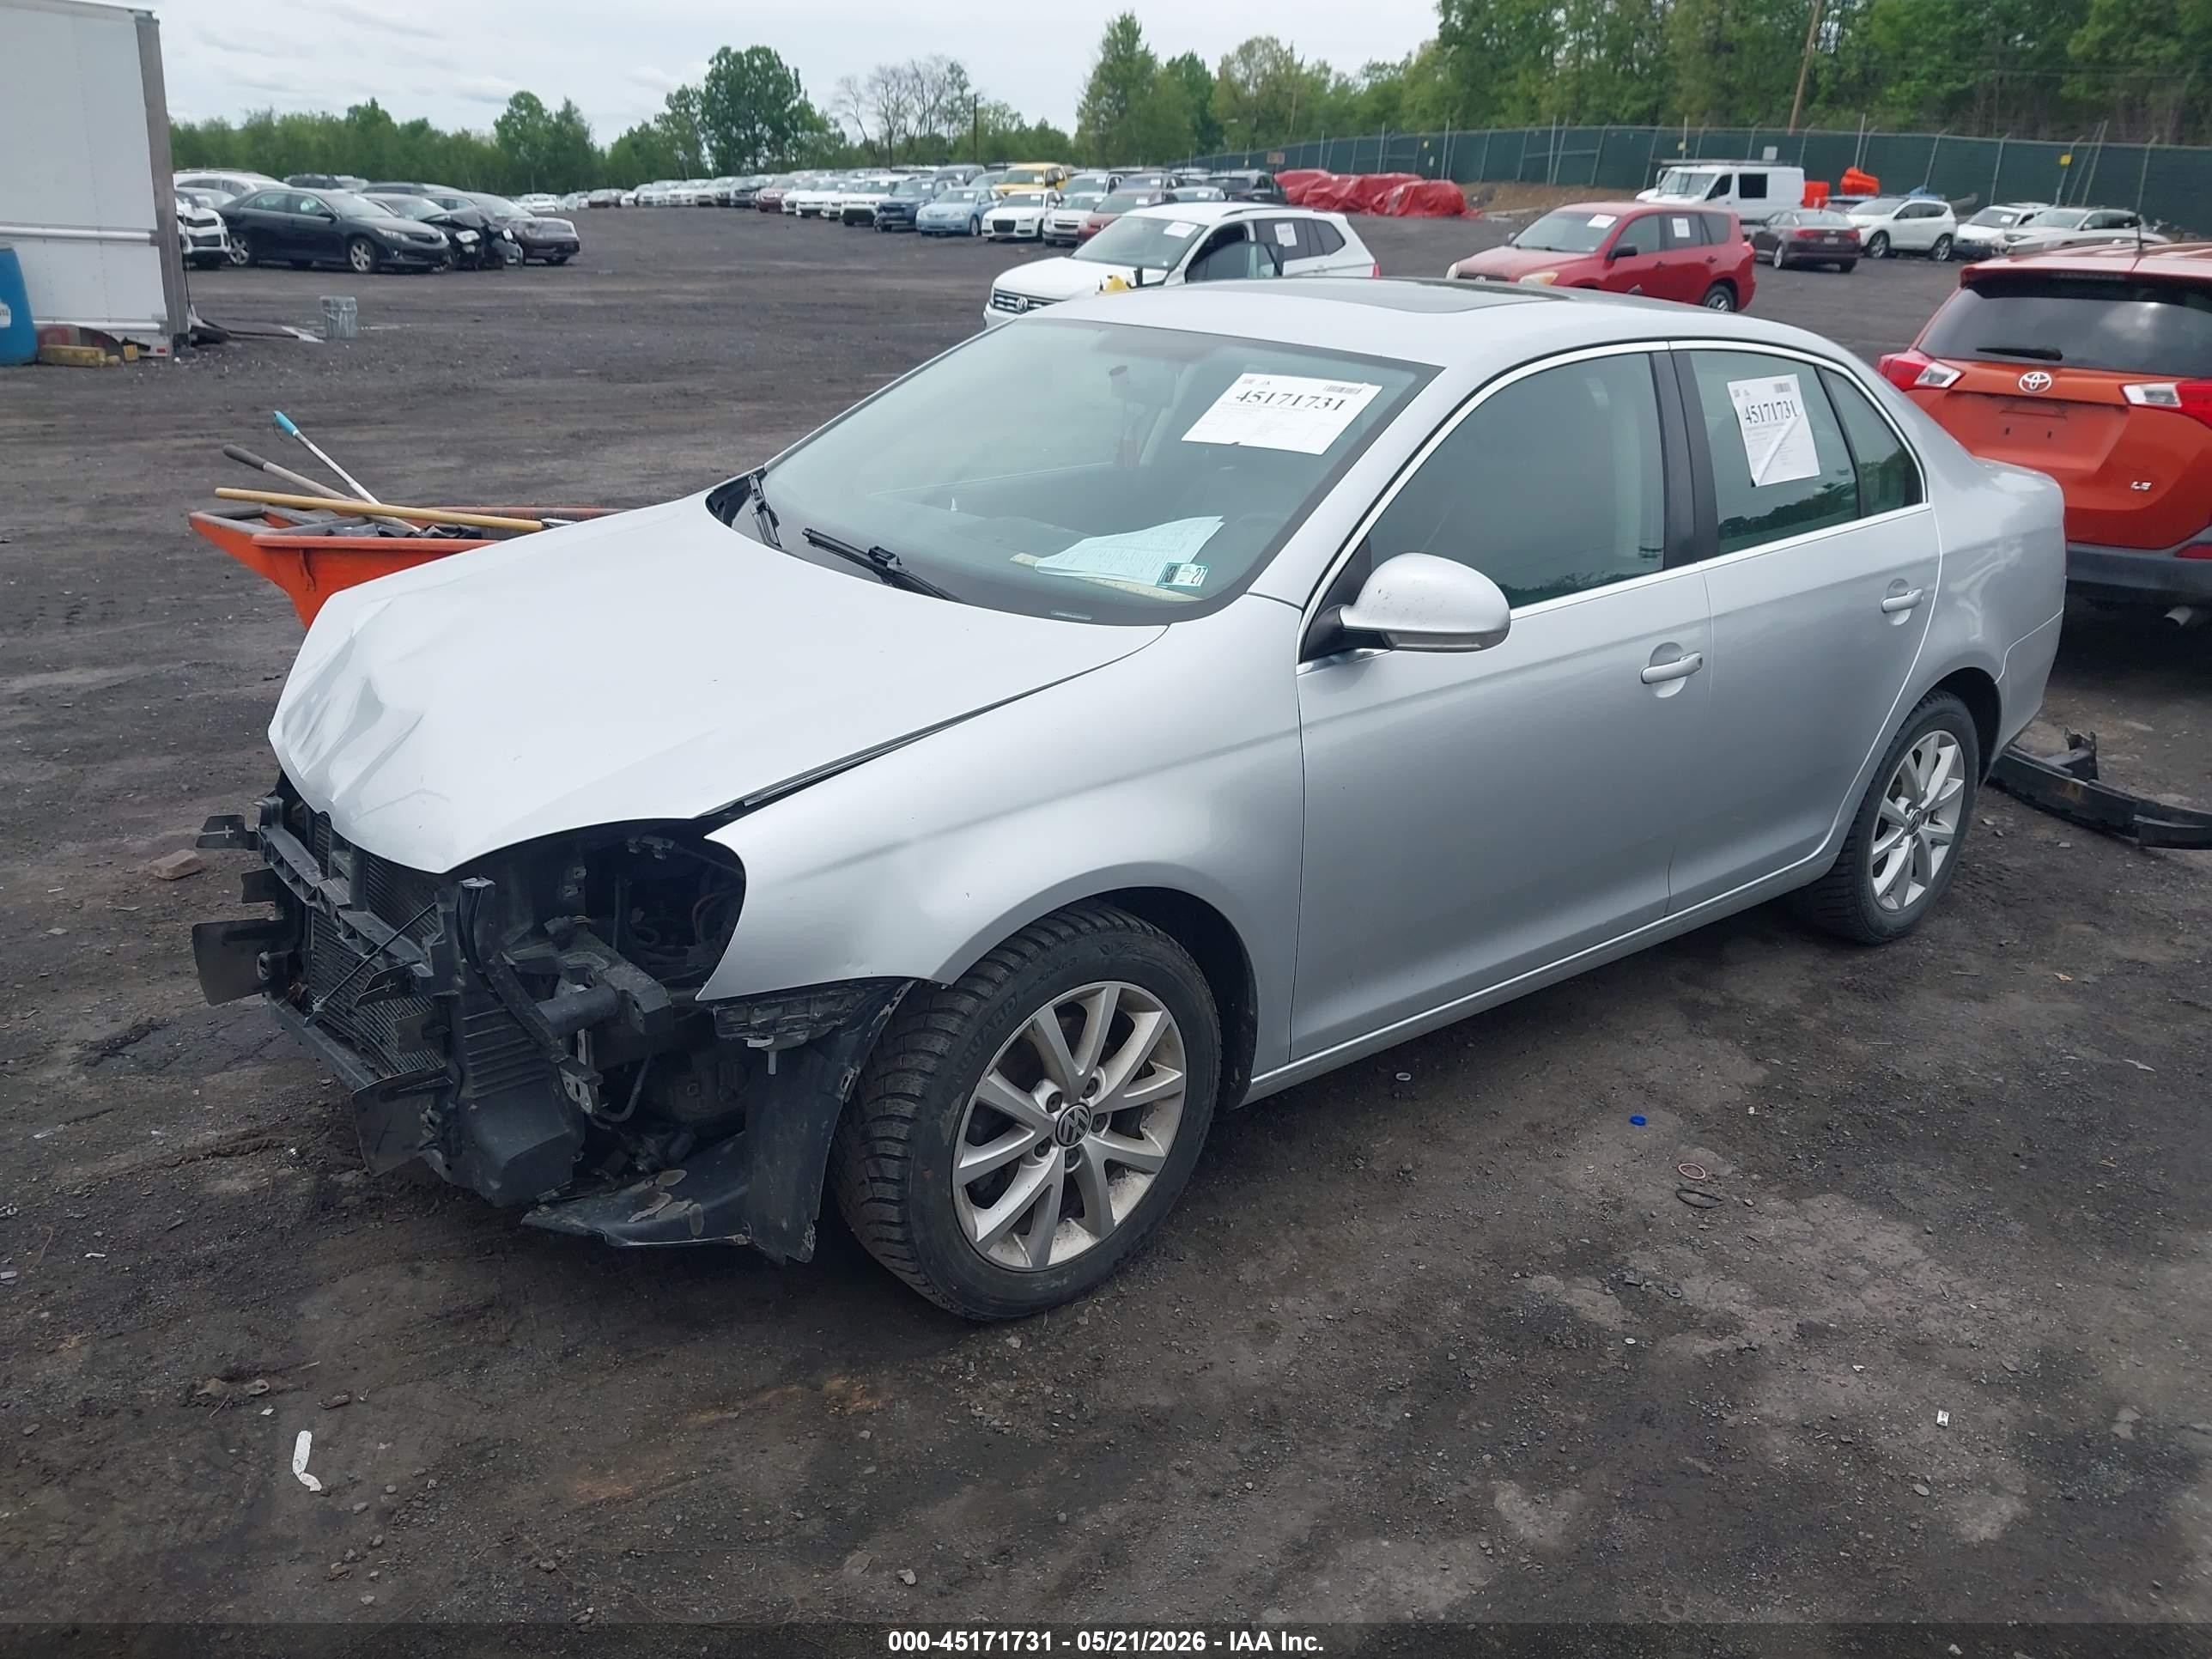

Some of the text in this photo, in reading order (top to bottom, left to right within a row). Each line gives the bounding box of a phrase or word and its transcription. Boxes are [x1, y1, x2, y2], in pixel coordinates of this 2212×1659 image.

[1236, 390, 1346, 411] 45171731
[1745, 398, 1797, 424] 45171731
[1190, 567, 1207, 585] 27
